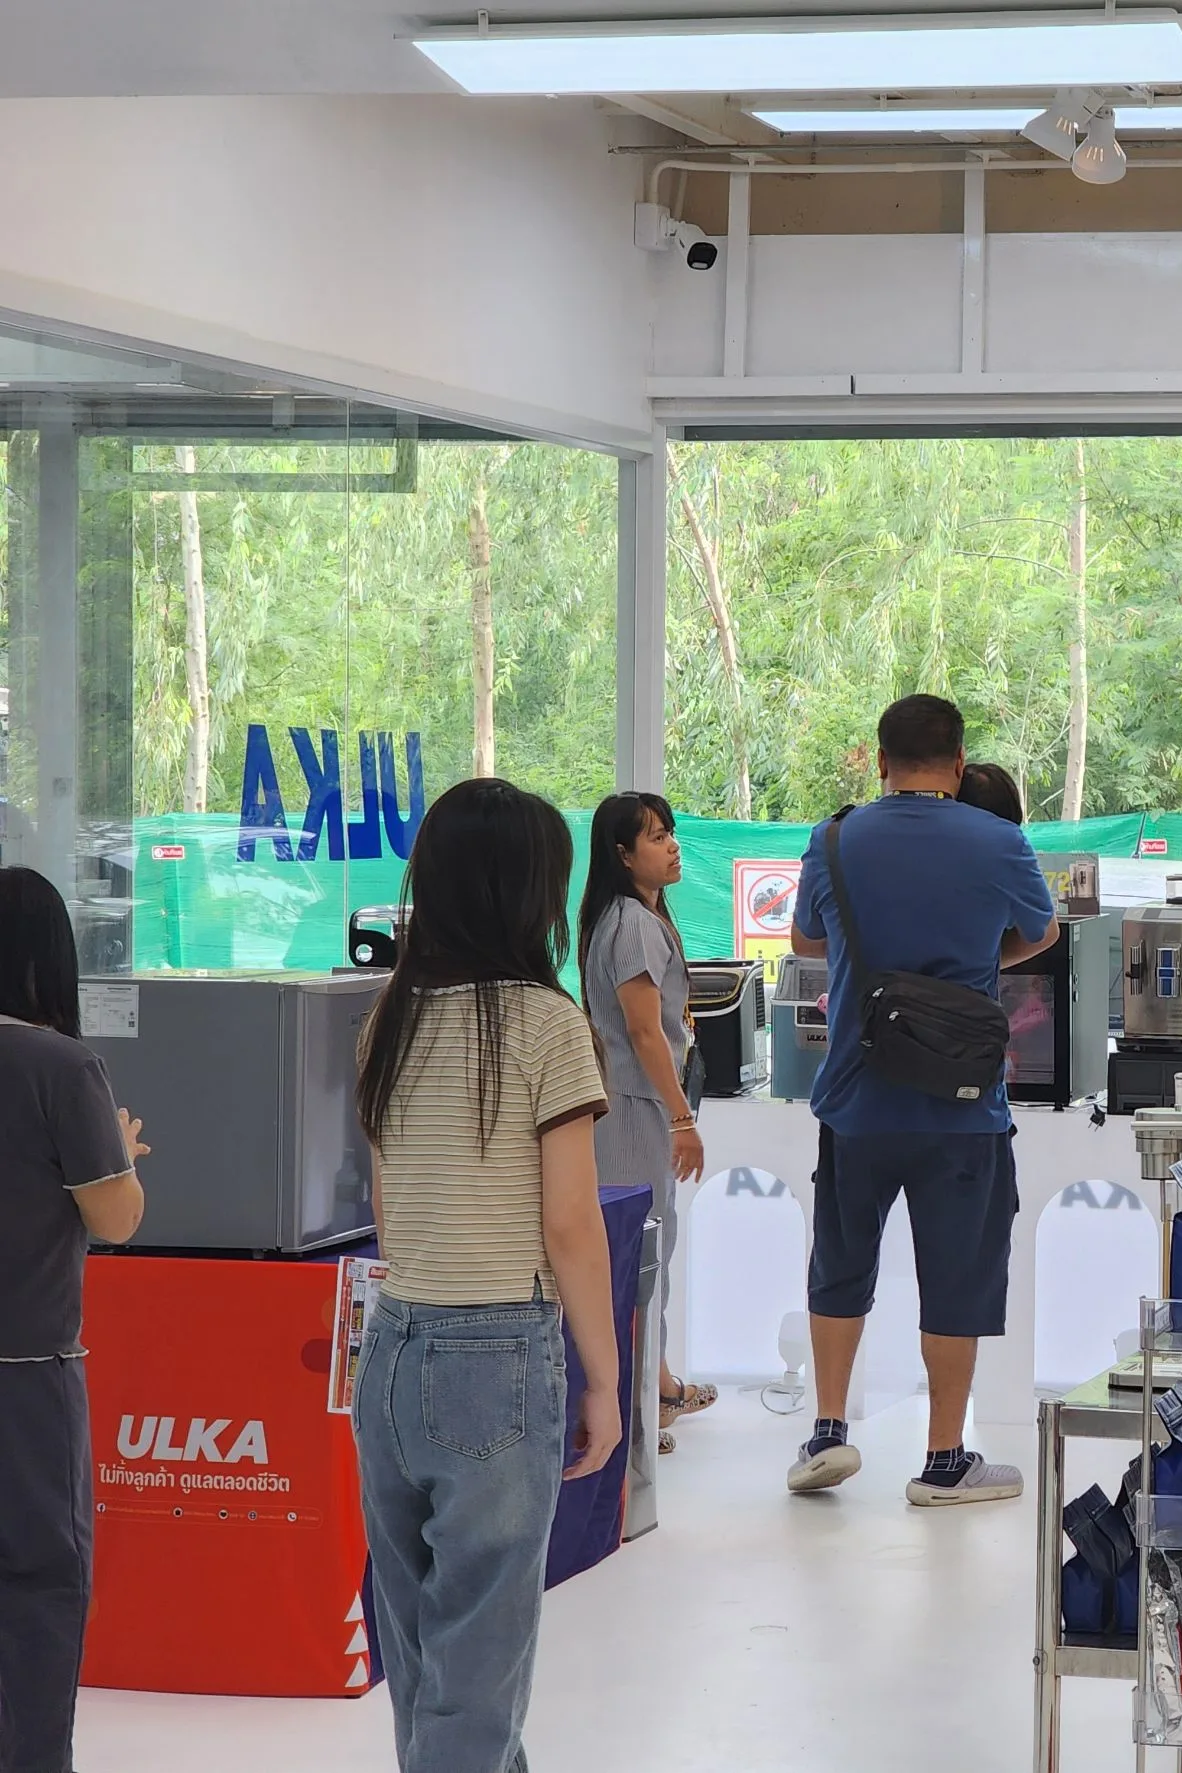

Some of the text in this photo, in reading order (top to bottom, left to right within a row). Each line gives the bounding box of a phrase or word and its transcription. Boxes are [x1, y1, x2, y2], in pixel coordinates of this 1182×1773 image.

[806, 1034, 828, 1042] ULKA
[117, 1414, 269, 1465] ULKA
[98, 1459, 290, 1494] ไม่ทิ้งลูกค้า ดูแลตลอดชีวิต
